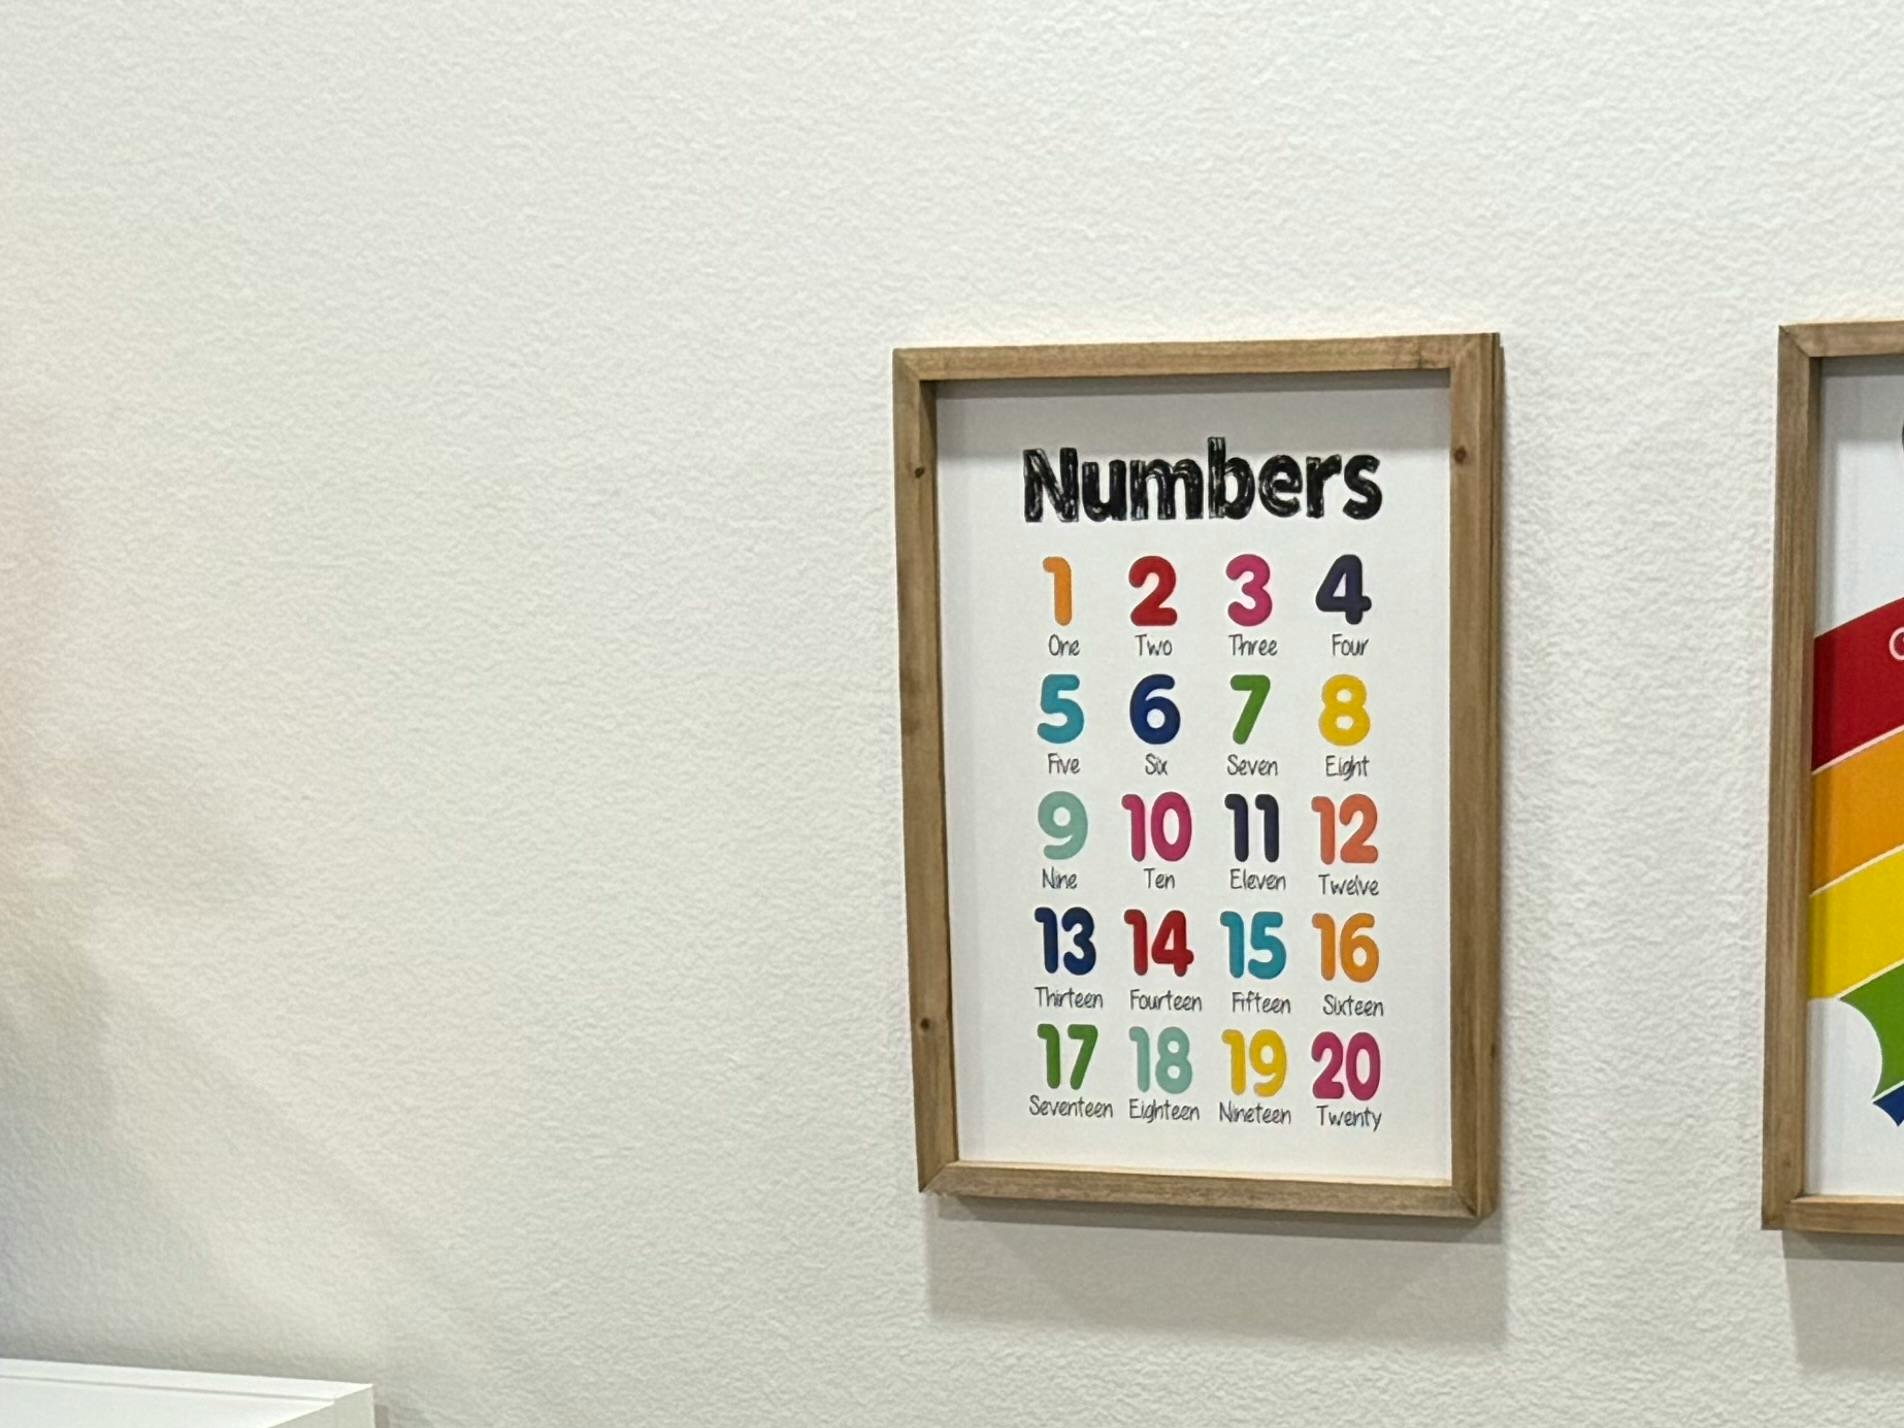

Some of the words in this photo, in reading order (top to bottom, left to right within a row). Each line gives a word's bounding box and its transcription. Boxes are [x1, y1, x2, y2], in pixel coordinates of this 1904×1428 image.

[1023, 437, 1382, 522] Numbers
[1042, 556, 1073, 627] 1
[1128, 555, 1178, 627] 2
[1226, 554, 1273, 627] 3
[1315, 554, 1372, 625] 4
[1048, 634, 1080, 656] One
[1134, 634, 1172, 656] Two
[1228, 634, 1278, 656] Three
[1332, 634, 1369, 656] Four
[1037, 674, 1085, 744] 5
[1129, 674, 1181, 745] 6
[1230, 674, 1271, 745] 7
[1318, 674, 1372, 748] 8
[1048, 753, 1080, 775] Five
[1145, 753, 1168, 775] Six
[1227, 754, 1278, 776] Seven
[1325, 755, 1370, 781] Eight
[1038, 791, 1088, 860] 9
[1121, 791, 1192, 862] 10
[1224, 794, 1279, 863] 11
[1311, 793, 1379, 865] 12
[1042, 866, 1077, 889] Nine
[1144, 868, 1175, 889] Ten
[1230, 868, 1286, 890] Eleven
[1318, 873, 1379, 896] Twelve
[1034, 907, 1097, 976] 13
[1124, 909, 1195, 977] 14
[1220, 911, 1287, 980] 15
[1312, 913, 1380, 983] 16
[1034, 986, 1103, 1008] Thirteen
[1130, 989, 1202, 1011] Fourteen
[1232, 991, 1291, 1014] Fifteen
[1323, 994, 1384, 1016] Sixteen
[1037, 1024, 1099, 1090] 17
[1129, 1026, 1193, 1094] 18
[1221, 1029, 1288, 1098] 19
[1311, 1031, 1381, 1101] 20
[1029, 1095, 1113, 1118] Seventeen
[1129, 1098, 1200, 1124] Eighteen
[1219, 1100, 1291, 1124] Nineteen
[1316, 1105, 1382, 1132] Twenty
